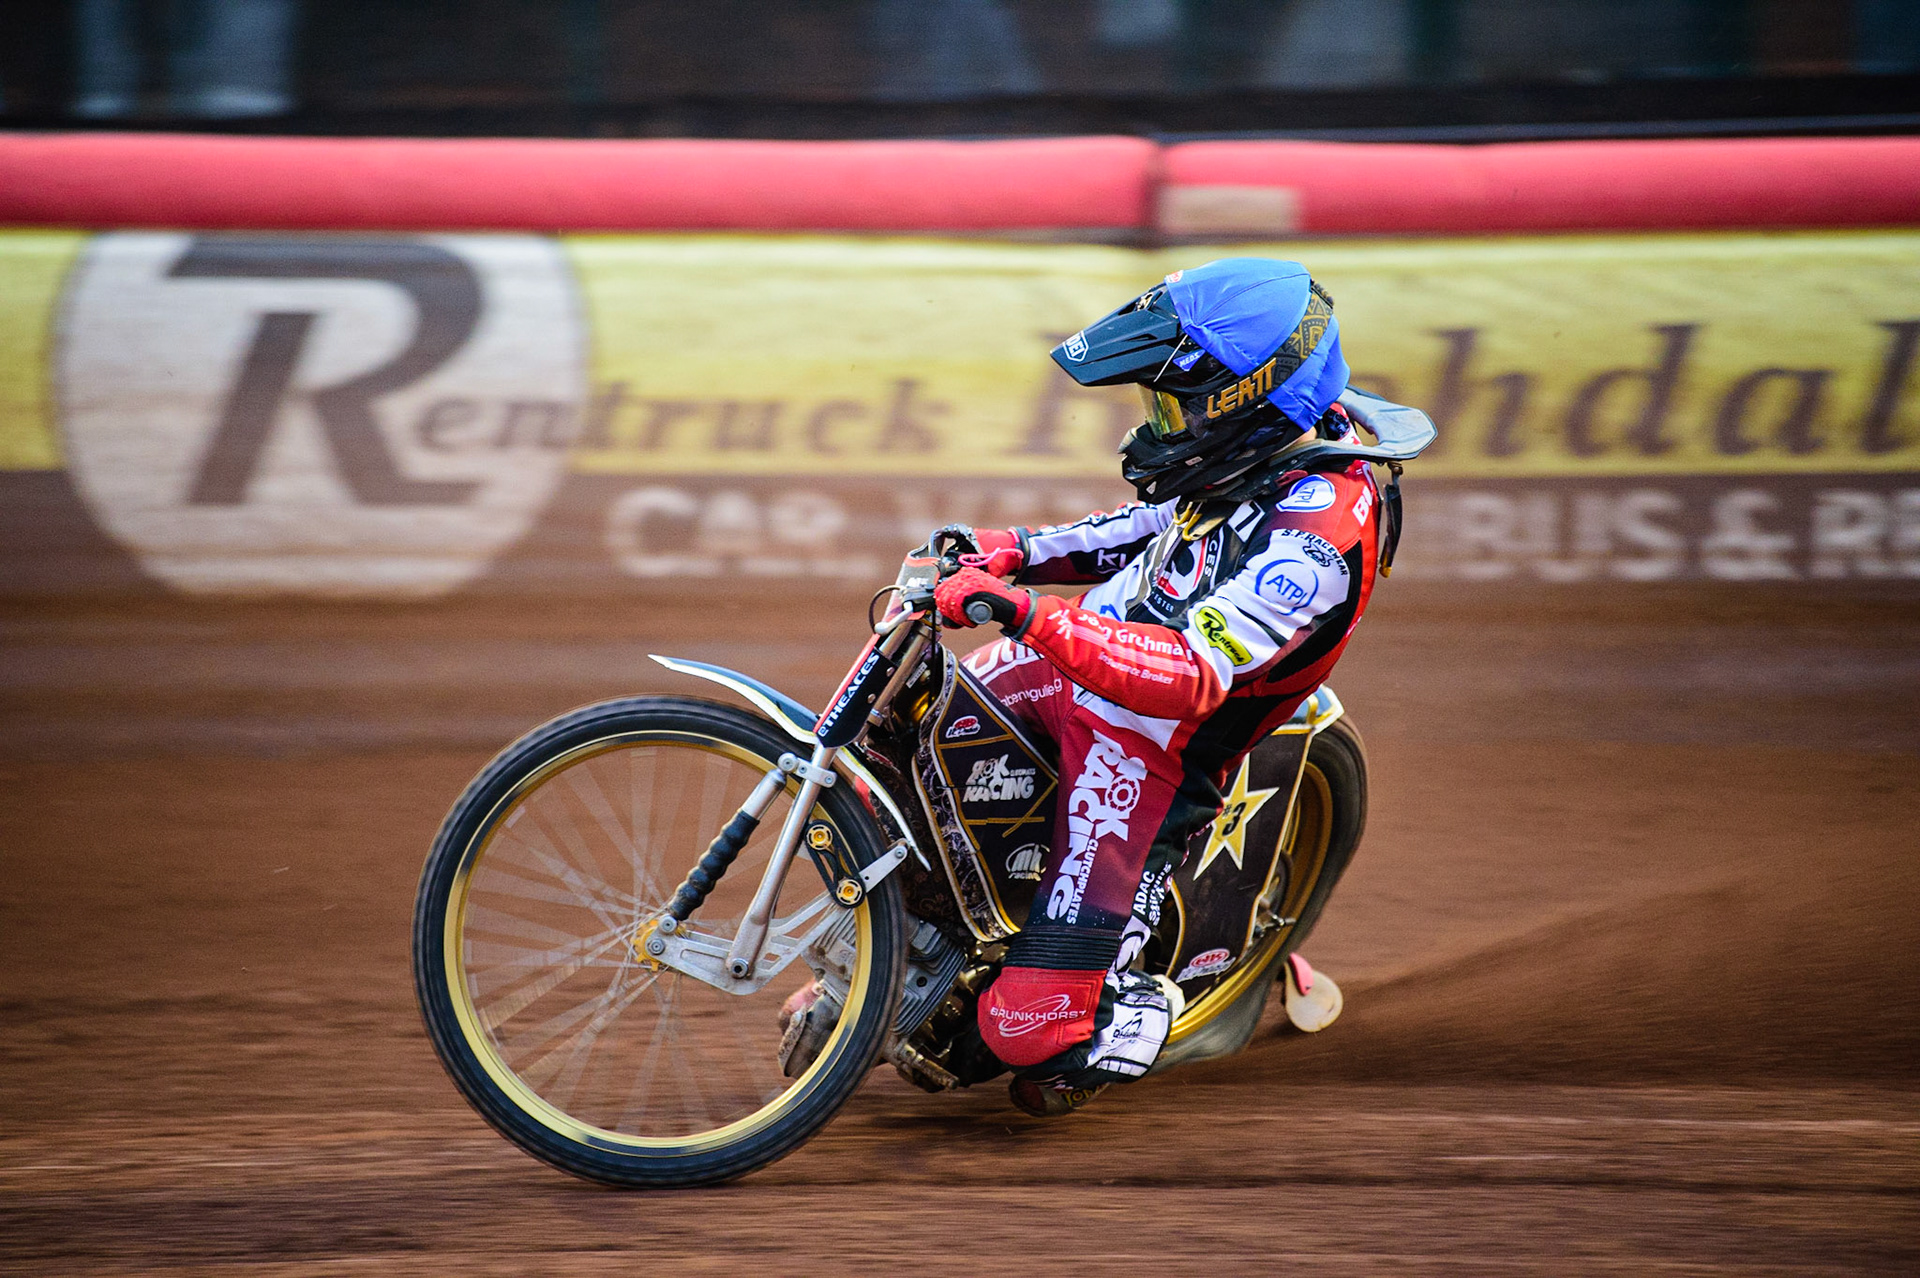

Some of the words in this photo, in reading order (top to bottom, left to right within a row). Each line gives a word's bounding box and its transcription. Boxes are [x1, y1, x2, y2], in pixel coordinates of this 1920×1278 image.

[1206, 357, 1276, 419] LEATT
[1141, 667, 1175, 685] Broker
[1066, 838, 1099, 925] CLUTCHPLATES
[1133, 870, 1156, 915] ADAC
[990, 1006, 1087, 1022] BRUNKHORST
